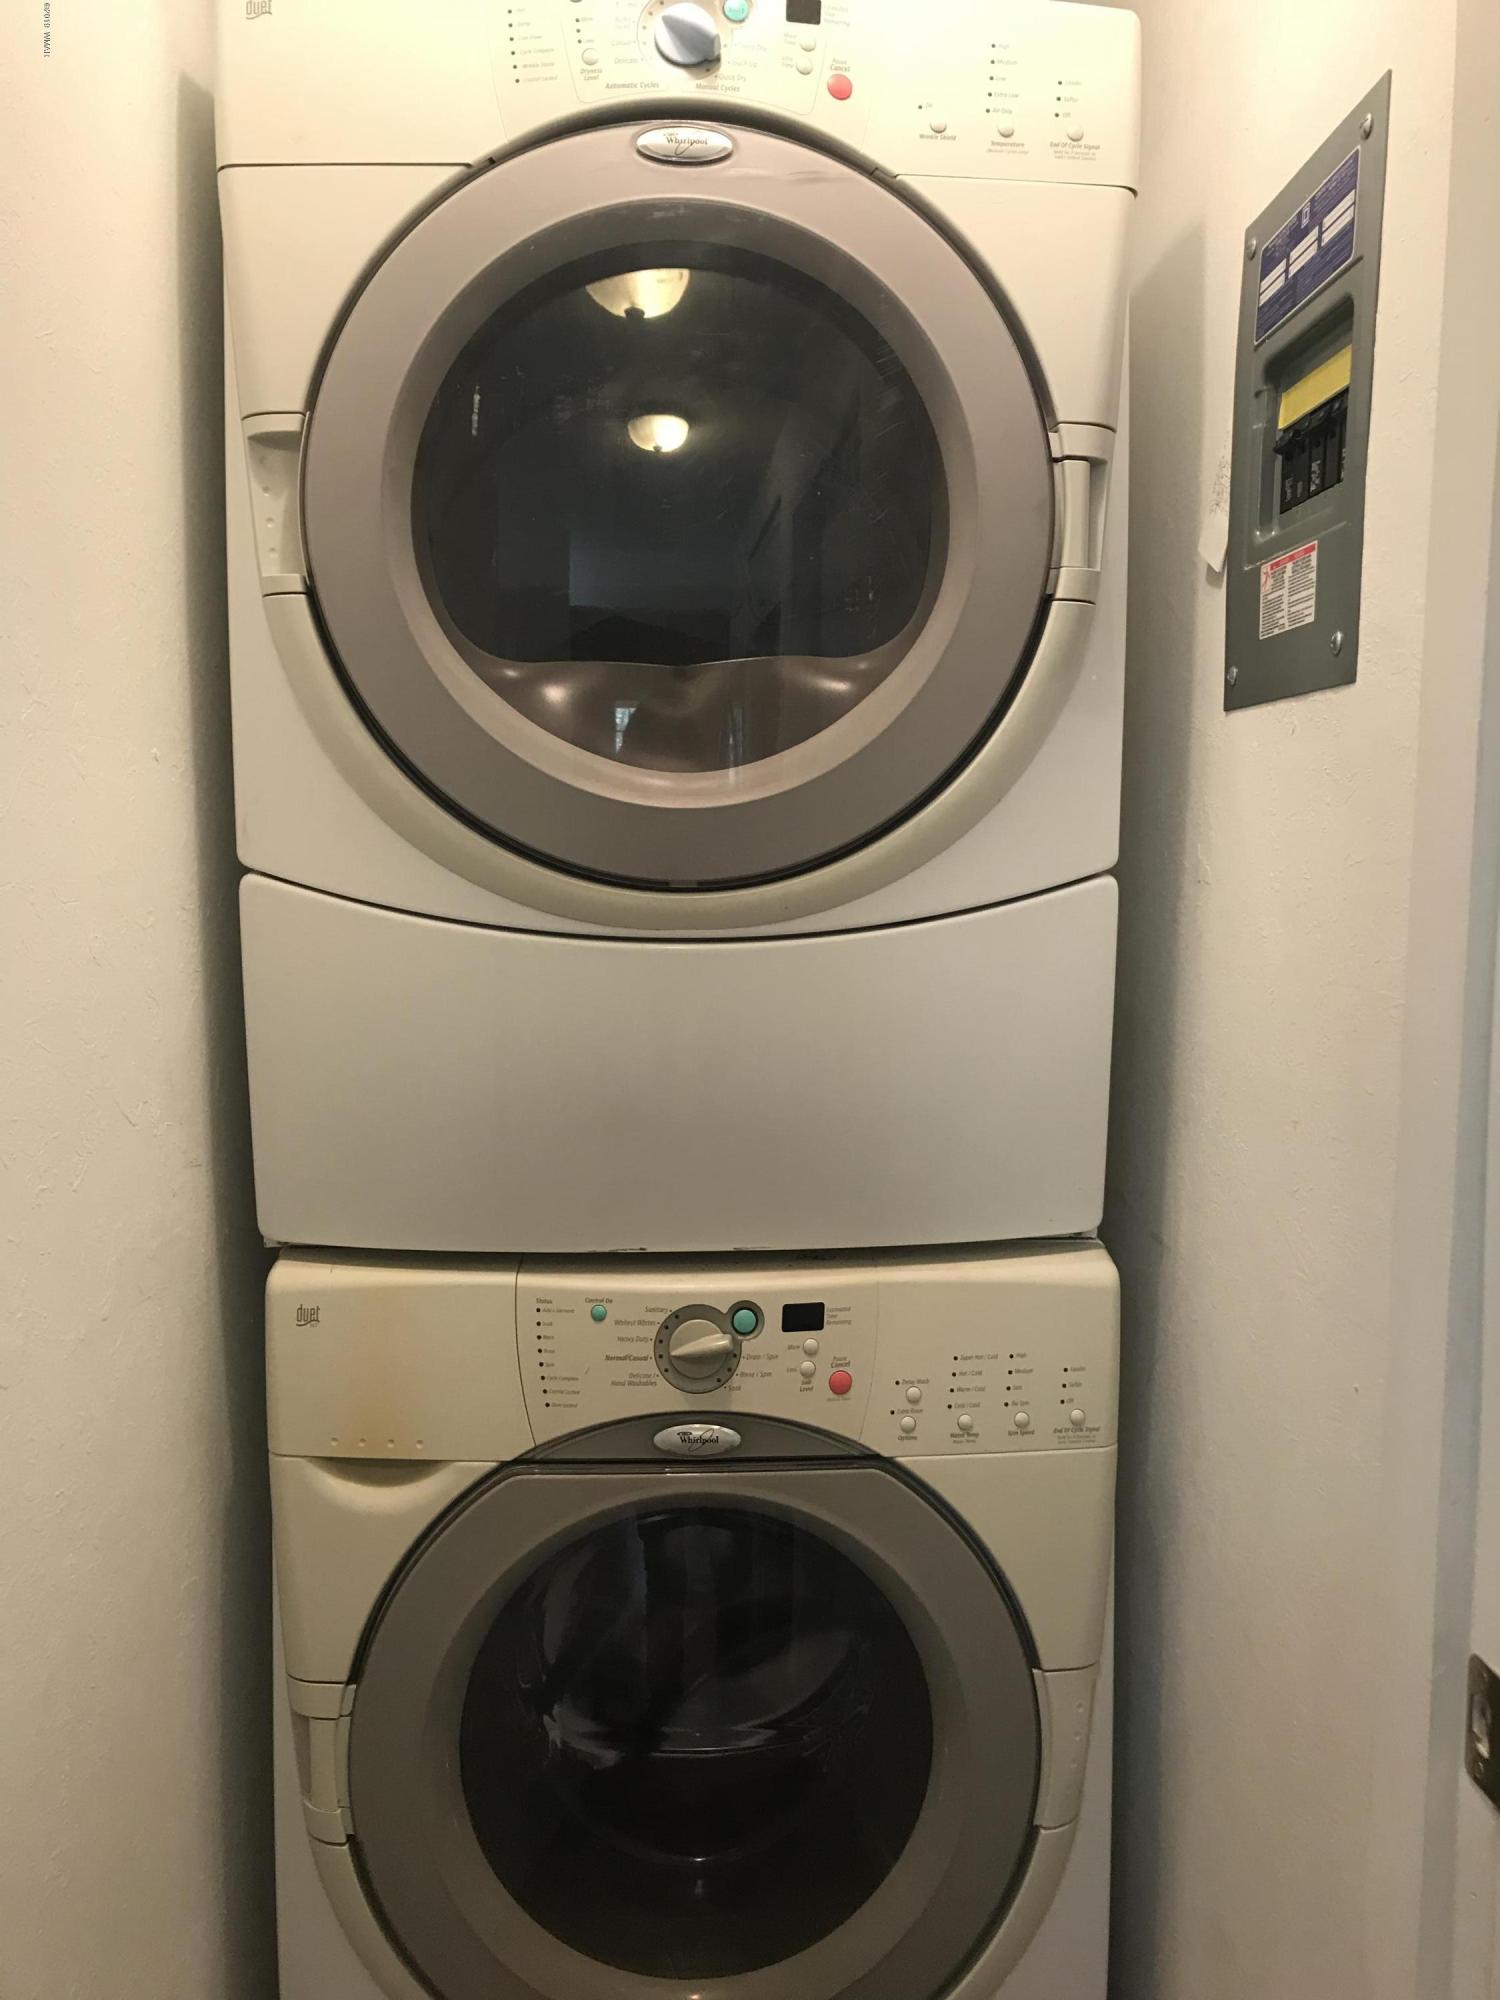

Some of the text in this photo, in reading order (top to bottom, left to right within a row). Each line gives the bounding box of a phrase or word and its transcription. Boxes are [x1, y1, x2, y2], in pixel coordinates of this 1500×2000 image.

[605, 81, 660, 90] Automatic Cycles
[720, 84, 740, 93] Cycles
[666, 136, 708, 147] Whirlpool
[296, 1304, 321, 1327] duet
[830, 1361, 851, 1369] Cancel
[679, 1435, 719, 1446] Whirlpool
